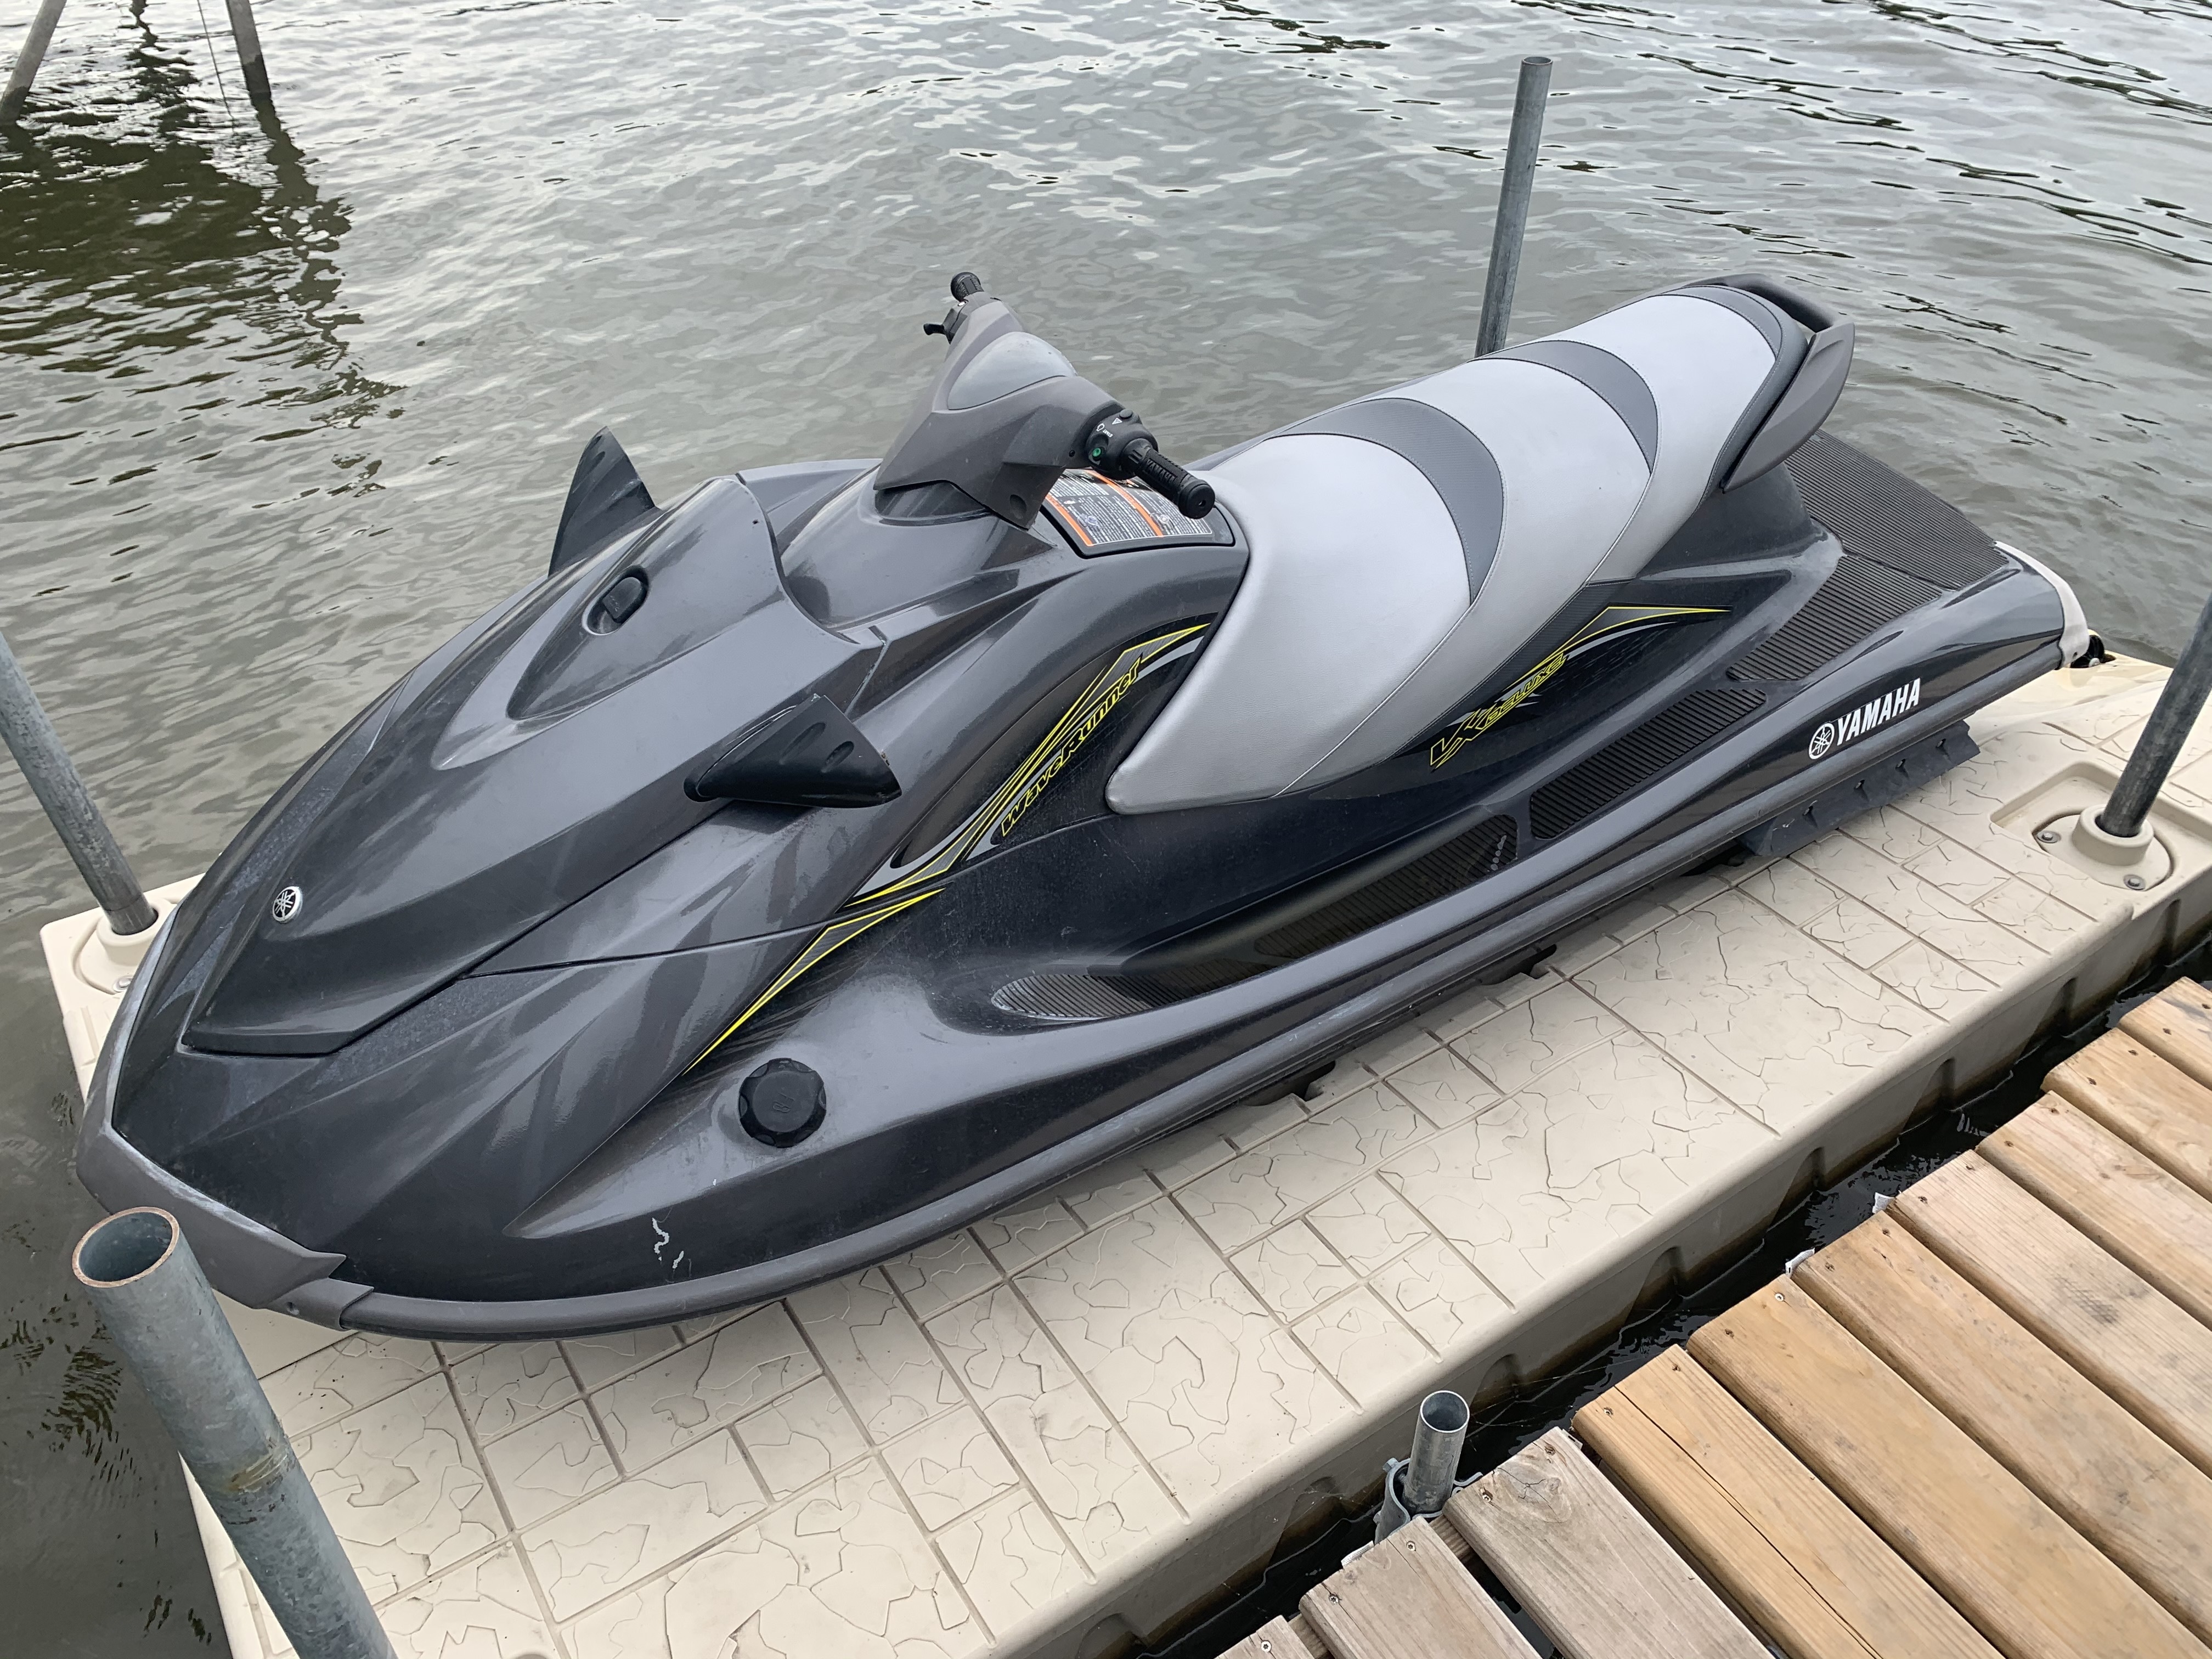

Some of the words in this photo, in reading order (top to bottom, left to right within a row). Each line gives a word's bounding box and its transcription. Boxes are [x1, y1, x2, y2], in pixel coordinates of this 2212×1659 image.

[1103, 429, 1113, 437] START
[1486, 652, 1567, 727] DELUXE
[1837, 678, 1920, 746] YAMAHA
[1002, 657, 1142, 837] WaveRunner
